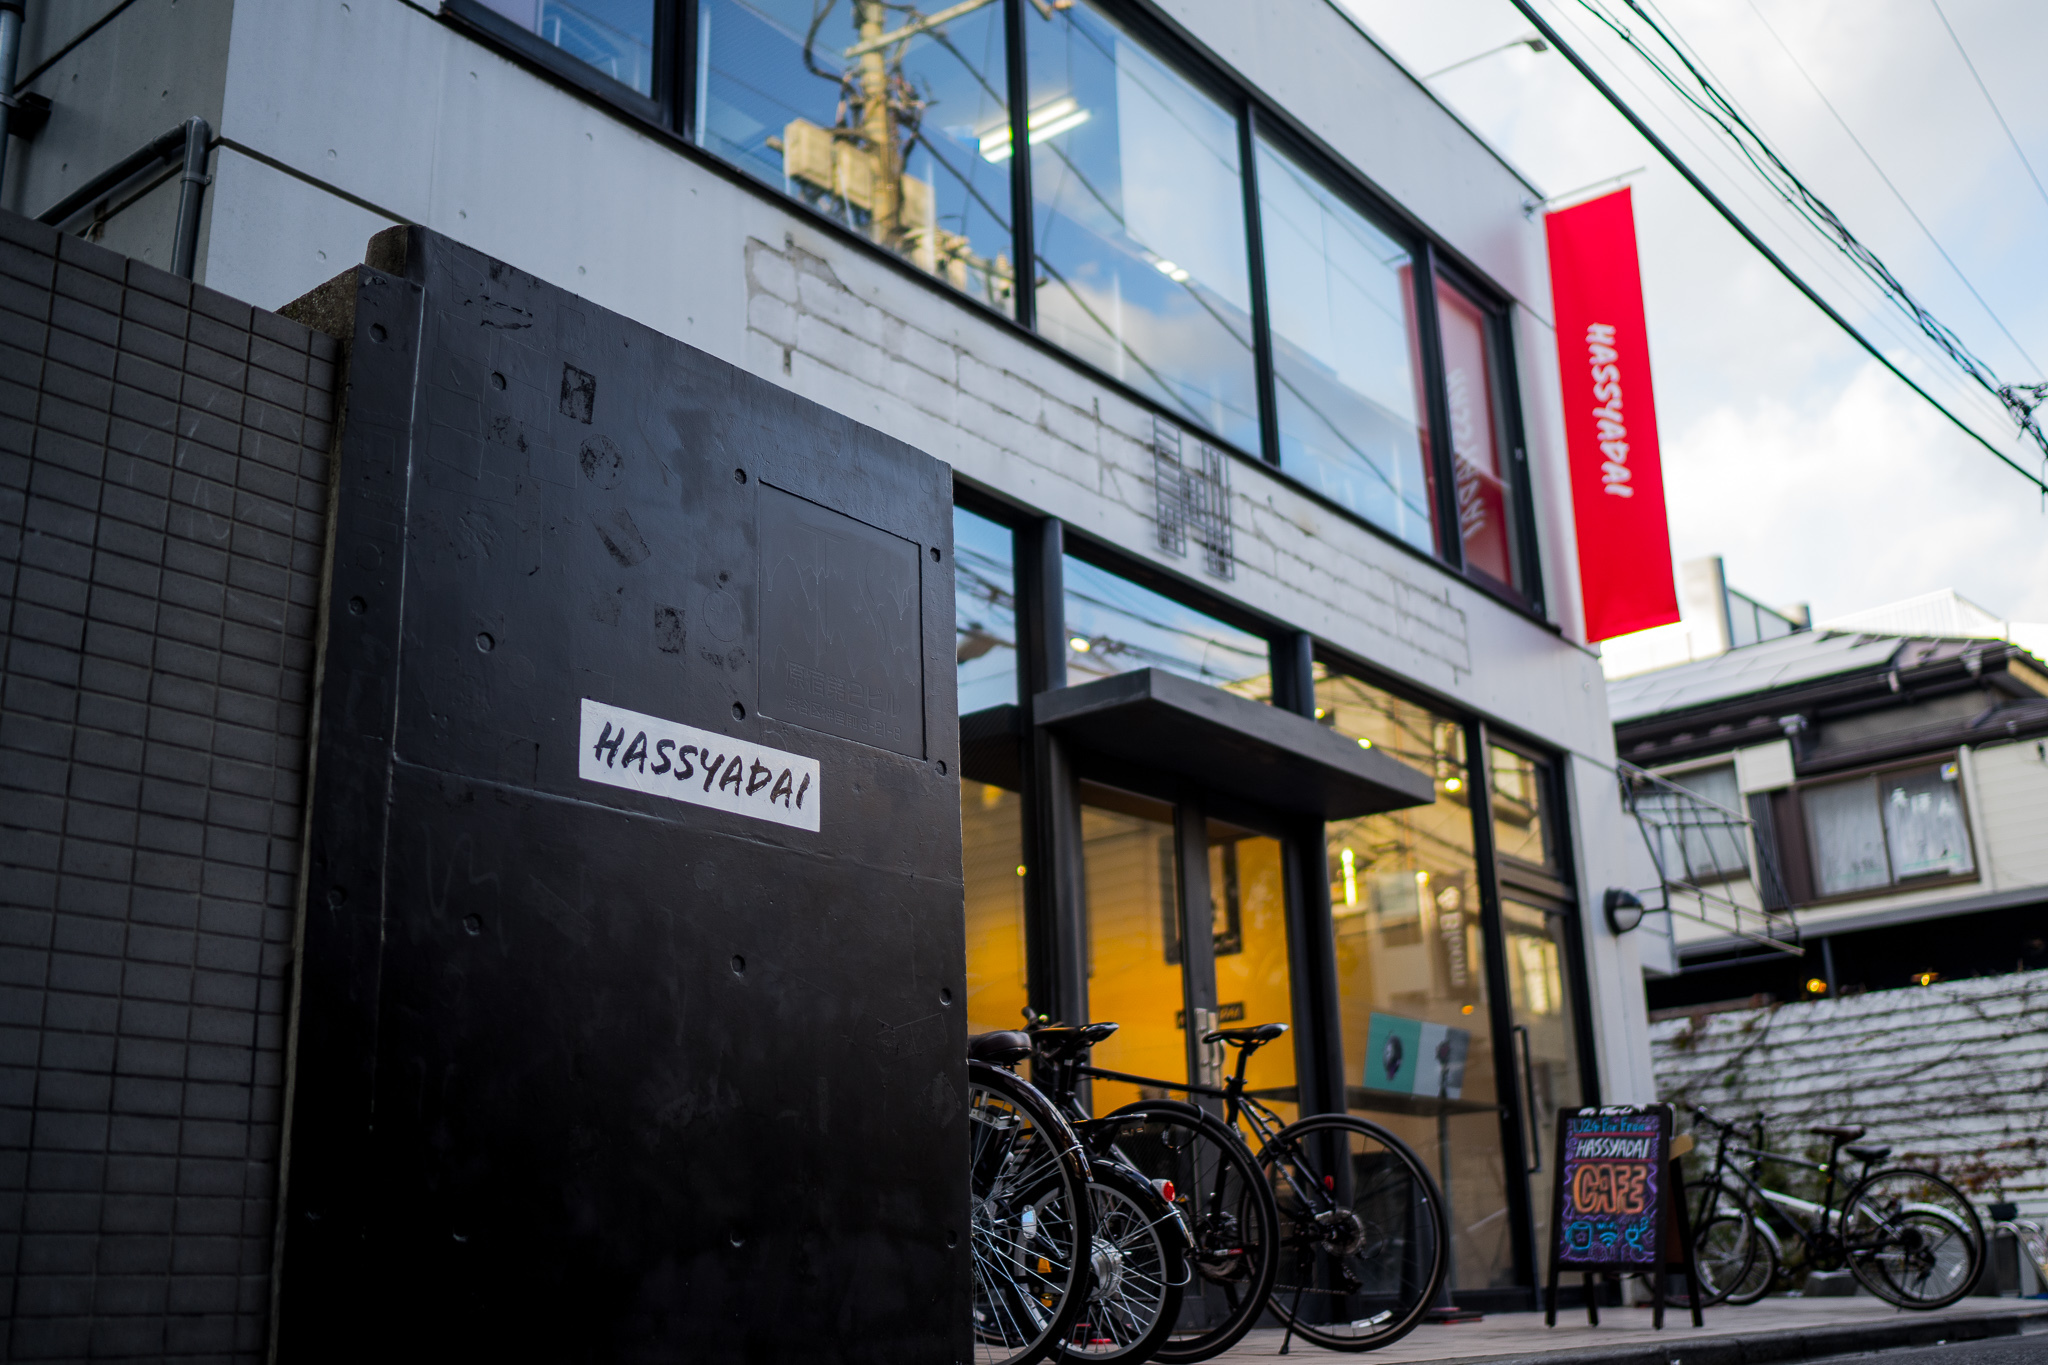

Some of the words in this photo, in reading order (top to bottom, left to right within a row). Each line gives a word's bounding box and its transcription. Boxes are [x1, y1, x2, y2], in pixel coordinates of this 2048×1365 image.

[1586, 322, 1634, 498] HASSYADAI
[784, 694, 858, 730] 渋谷区神宮前
[785, 660, 901, 718] 原宿第2ビル
[593, 721, 811, 810] HASSYADAI
[1575, 1137, 1650, 1159] HASSYADAI
[1573, 1163, 1647, 1214] CAFE
